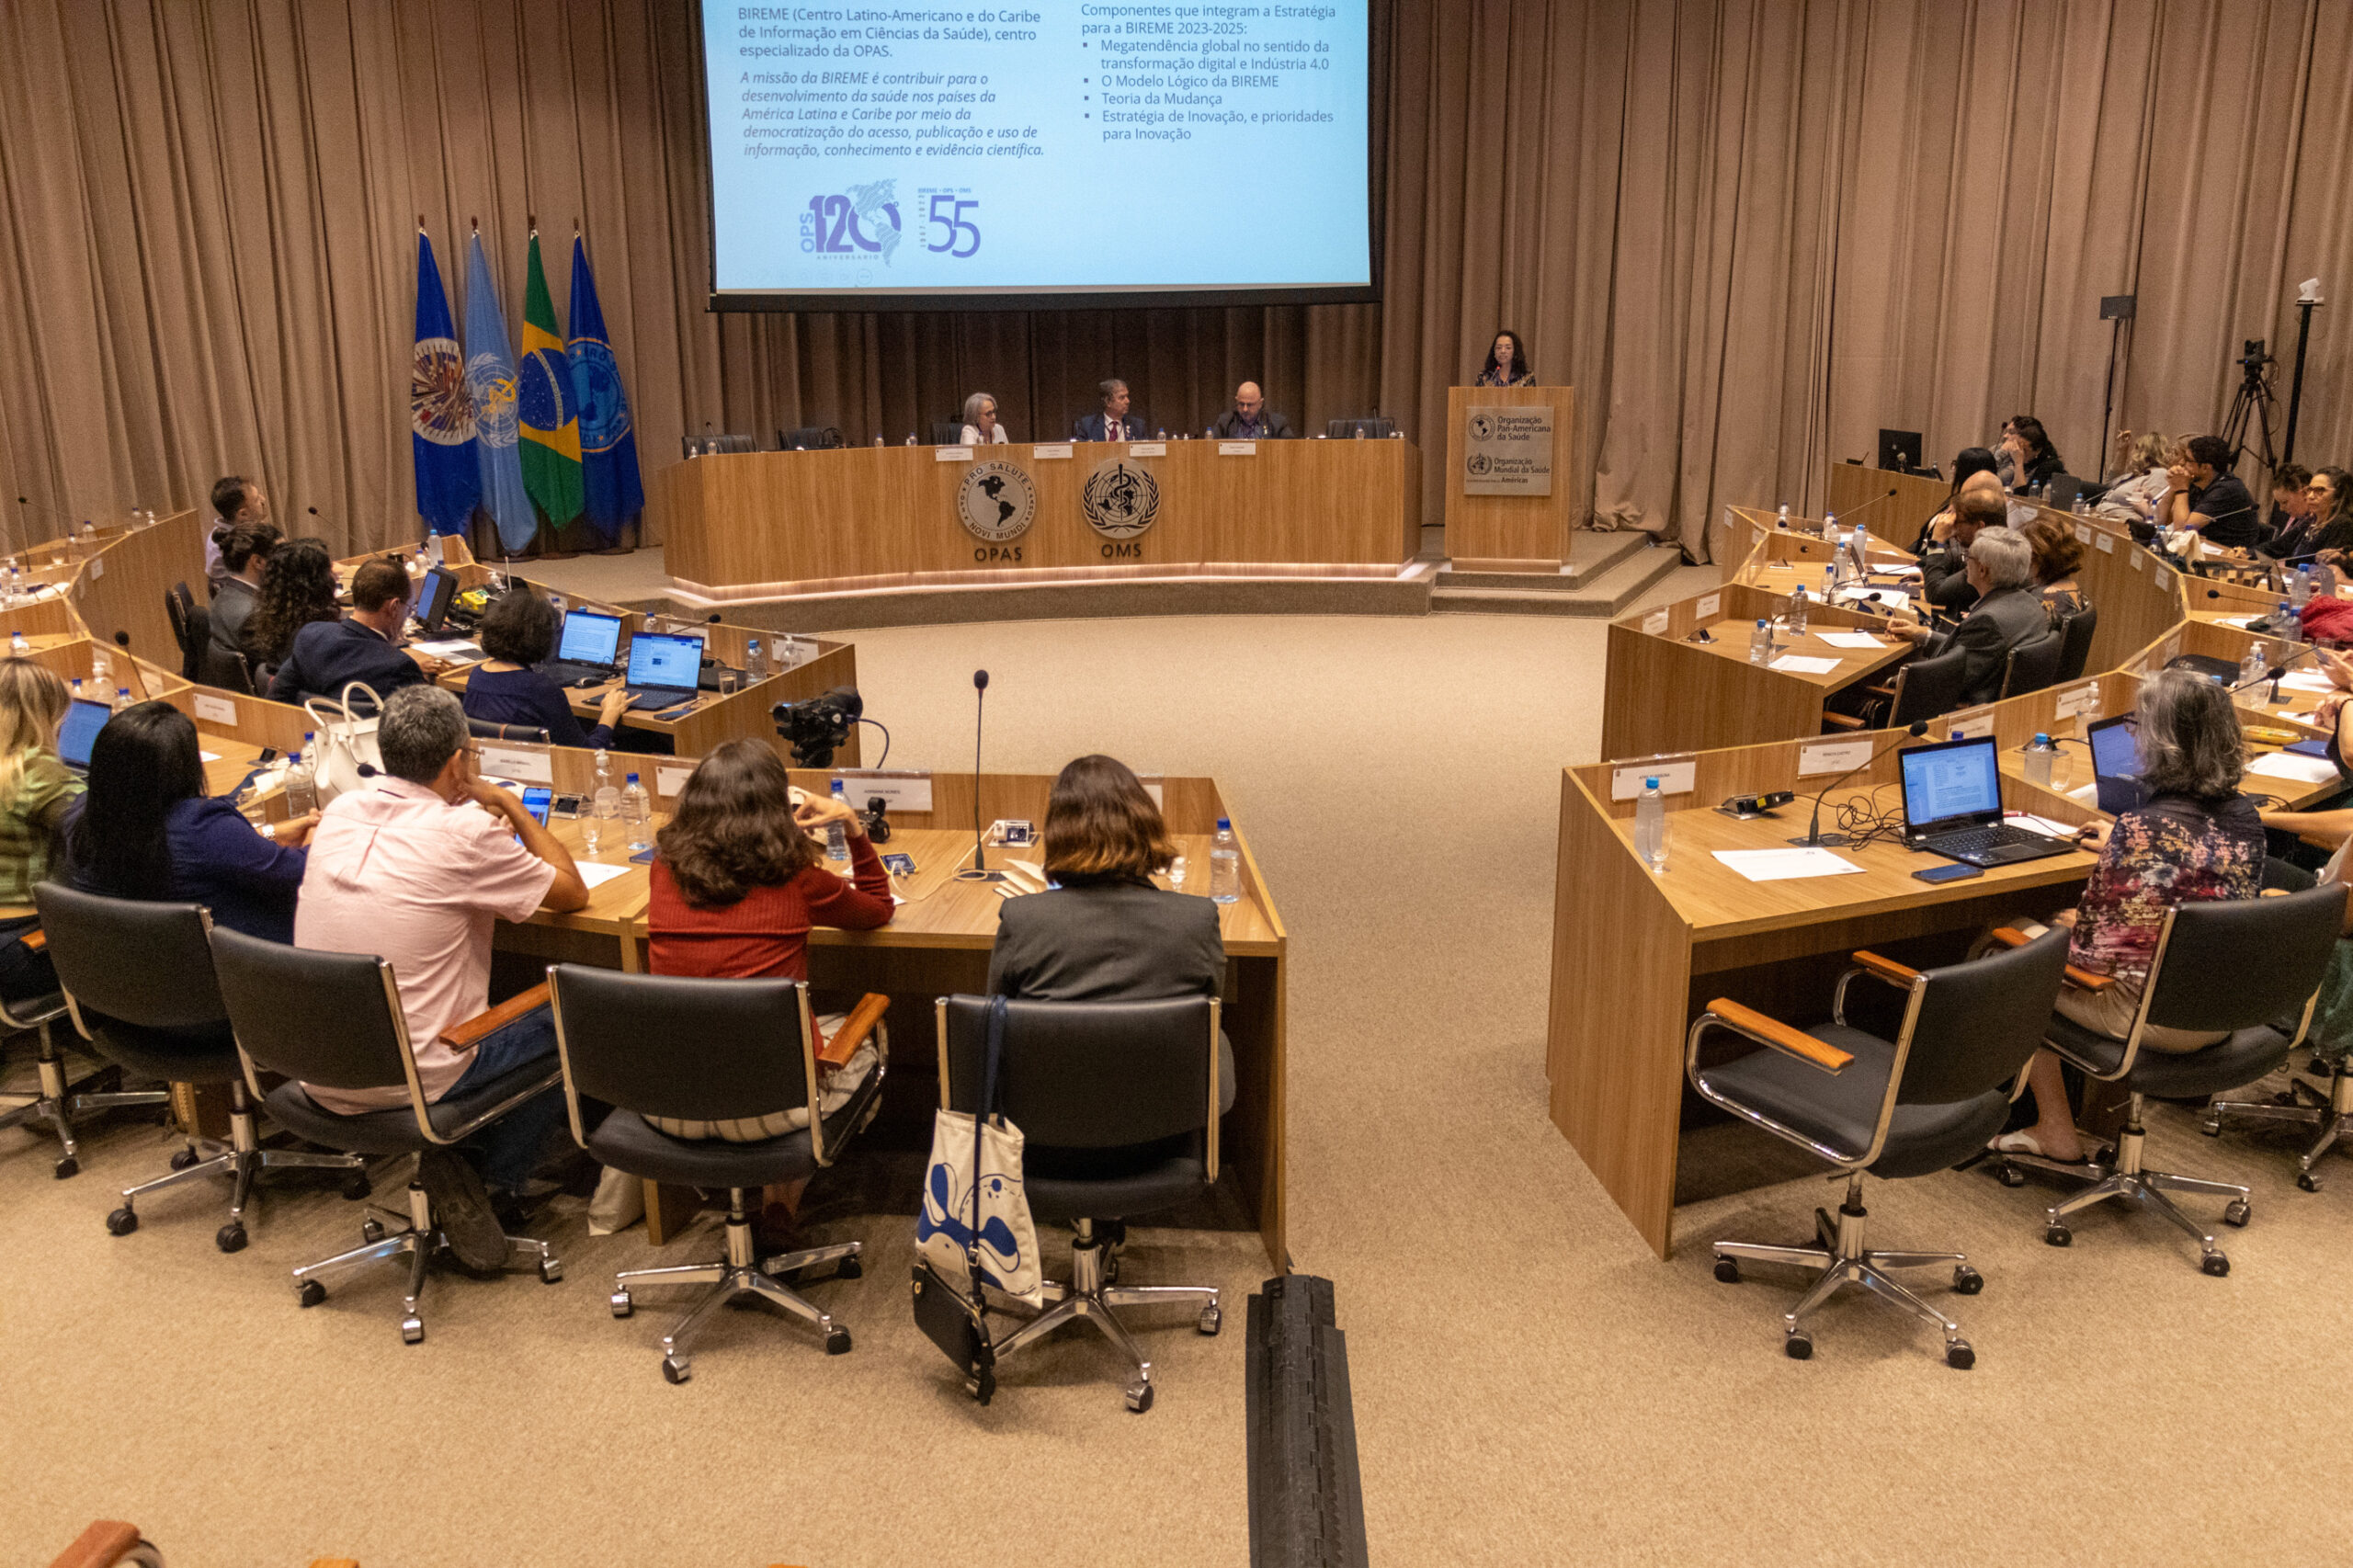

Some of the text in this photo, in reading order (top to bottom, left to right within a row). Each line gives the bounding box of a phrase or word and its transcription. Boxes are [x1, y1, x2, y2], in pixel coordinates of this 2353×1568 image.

[739, 7, 1040, 22] BIREME (Centro Latino-Americano e do Caribe
[1081, 5, 1336, 21] Componentes que integram a Estratégia
[739, 25, 1036, 42] de Informação em Ciências da Saúde), centro
[1082, 22, 1247, 37] para a BIREME 2023-2025:
[740, 43, 892, 60] especializado da OPAS.
[1101, 39, 1329, 55] Megatendência global no sentido da
[1101, 56, 1329, 73] transformação digital e Indústria 4.0
[740, 71, 988, 88] A missão da BIREME é contribuir para o
[1101, 74, 1279, 90] O Modelo Lógico da BIREME
[742, 89, 995, 106] desenvolvimento da saúde nos países da
[1101, 92, 1222, 108] Teoria da Mudança
[742, 107, 972, 123] América Latina e Caribe por meio da
[1103, 109, 1334, 125] Estratégia de Inovação, e prioridades
[744, 125, 1038, 142] democratização do acesso, publicação e uso de
[1103, 128, 1191, 142] para Inovação
[745, 142, 1043, 159] informação, conhecimento e evidência científica.
[799, 212, 815, 254] OPS
[927, 194, 982, 258] 55
[1497, 415, 1542, 426] Organização
[1496, 433, 1530, 441] da Saúde
[1497, 425, 1552, 433] Pan-Americana
[1494, 458, 1533, 467] Organização
[1494, 466, 1519, 474] Mundial
[1521, 465, 1529, 474] da
[964, 462, 1029, 485] PRO SALUTE
[1501, 476, 1529, 484] Américas
[969, 522, 1027, 540] NOVI MUNDI
[974, 547, 1022, 562] OPAS
[1101, 542, 1142, 558] OMS
